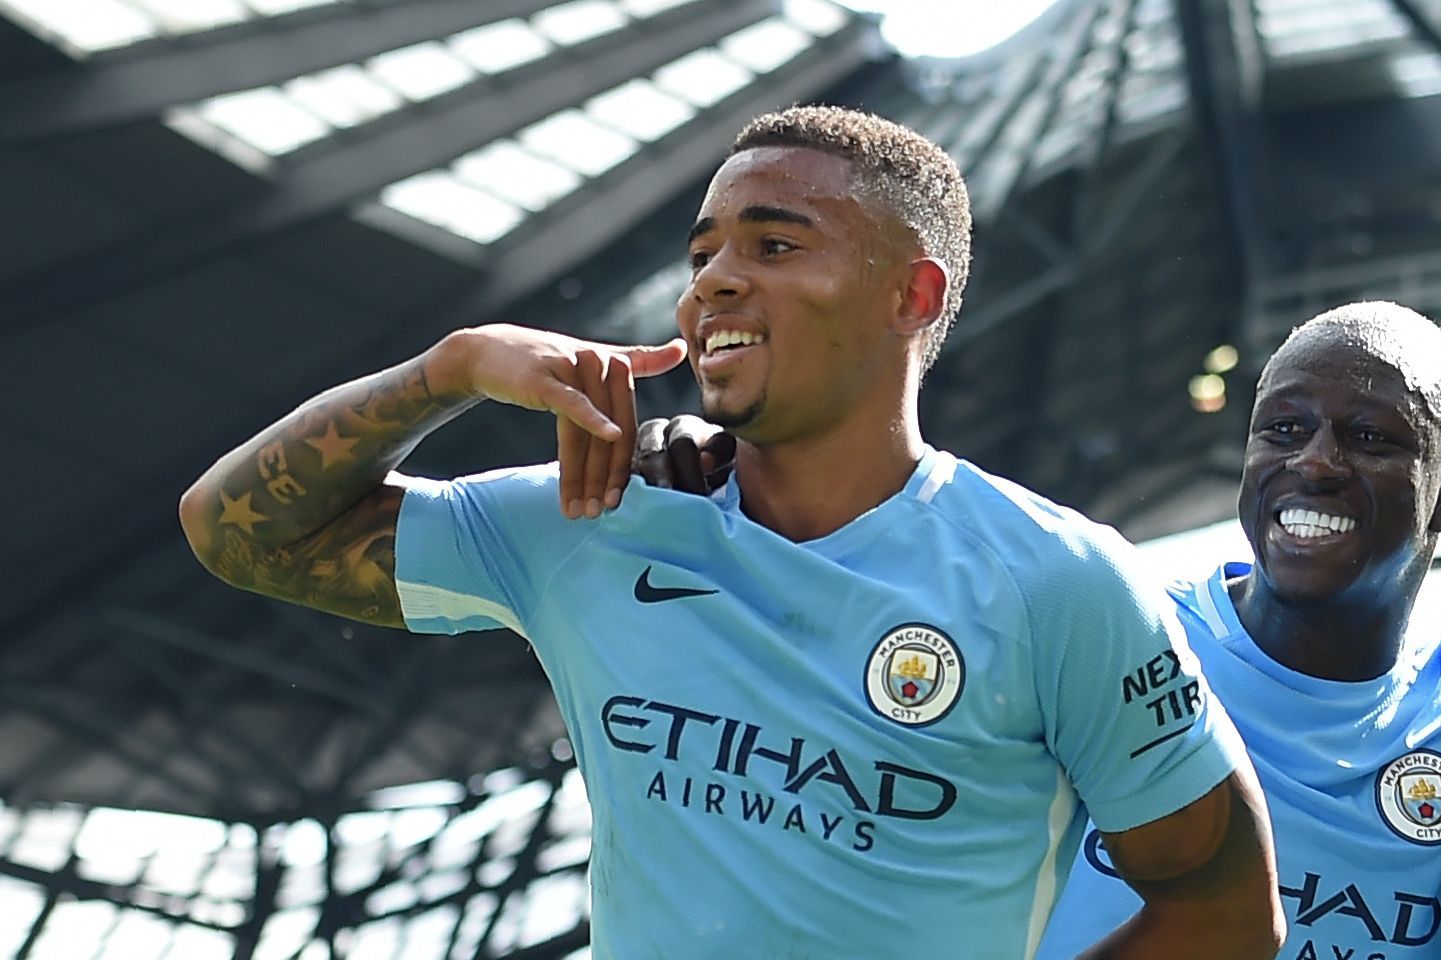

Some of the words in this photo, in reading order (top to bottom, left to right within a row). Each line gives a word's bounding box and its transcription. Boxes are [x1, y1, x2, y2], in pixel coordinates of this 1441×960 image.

[878, 630, 956, 668] MANCHESTER
[1122, 649, 1181, 704] NEX
[891, 707, 922, 721] CITY
[1145, 680, 1202, 727] TIR
[601, 695, 958, 822] ETIHAD
[646, 771, 876, 853] AIRWAYS
[1416, 828, 1441, 838] CITY
